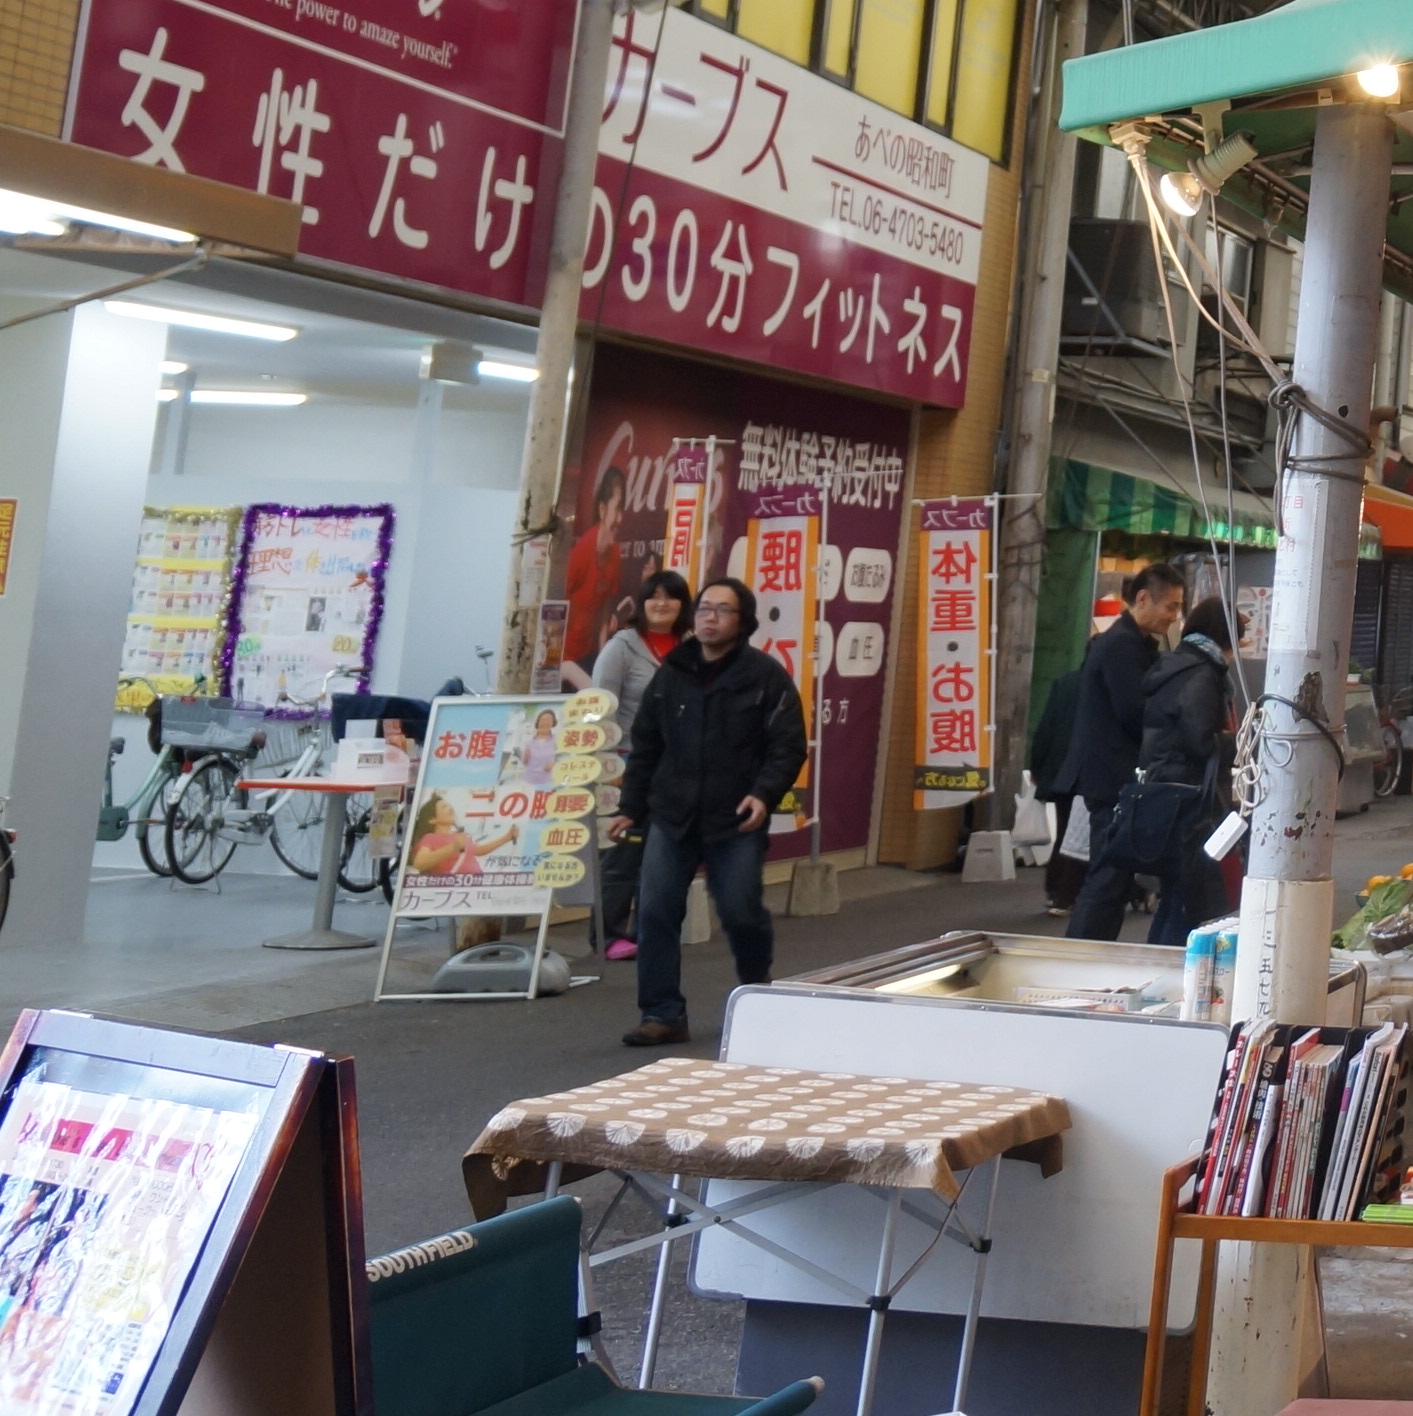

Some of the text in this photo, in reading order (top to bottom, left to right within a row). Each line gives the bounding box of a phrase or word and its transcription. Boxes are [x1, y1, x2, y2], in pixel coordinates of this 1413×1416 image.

[343, 13, 357, 33] to
[360, 20, 400, 51] amaze
[600, 11, 789, 193] カーブス
[118, 27, 534, 271] 女性だけ
[855, 115, 956, 200] あべの昭和町
[830, 181, 964, 266] TEL.06-4703-5480
[592, 420, 725, 515] Curs
[434, 729, 500, 761] お腹
[563, 729, 599, 749] 姿勢
[546, 828, 585, 847] 血圧
[401, 889, 493, 910] カーブス TEL
[366, 1231, 475, 1283] SOUTHFIELD
